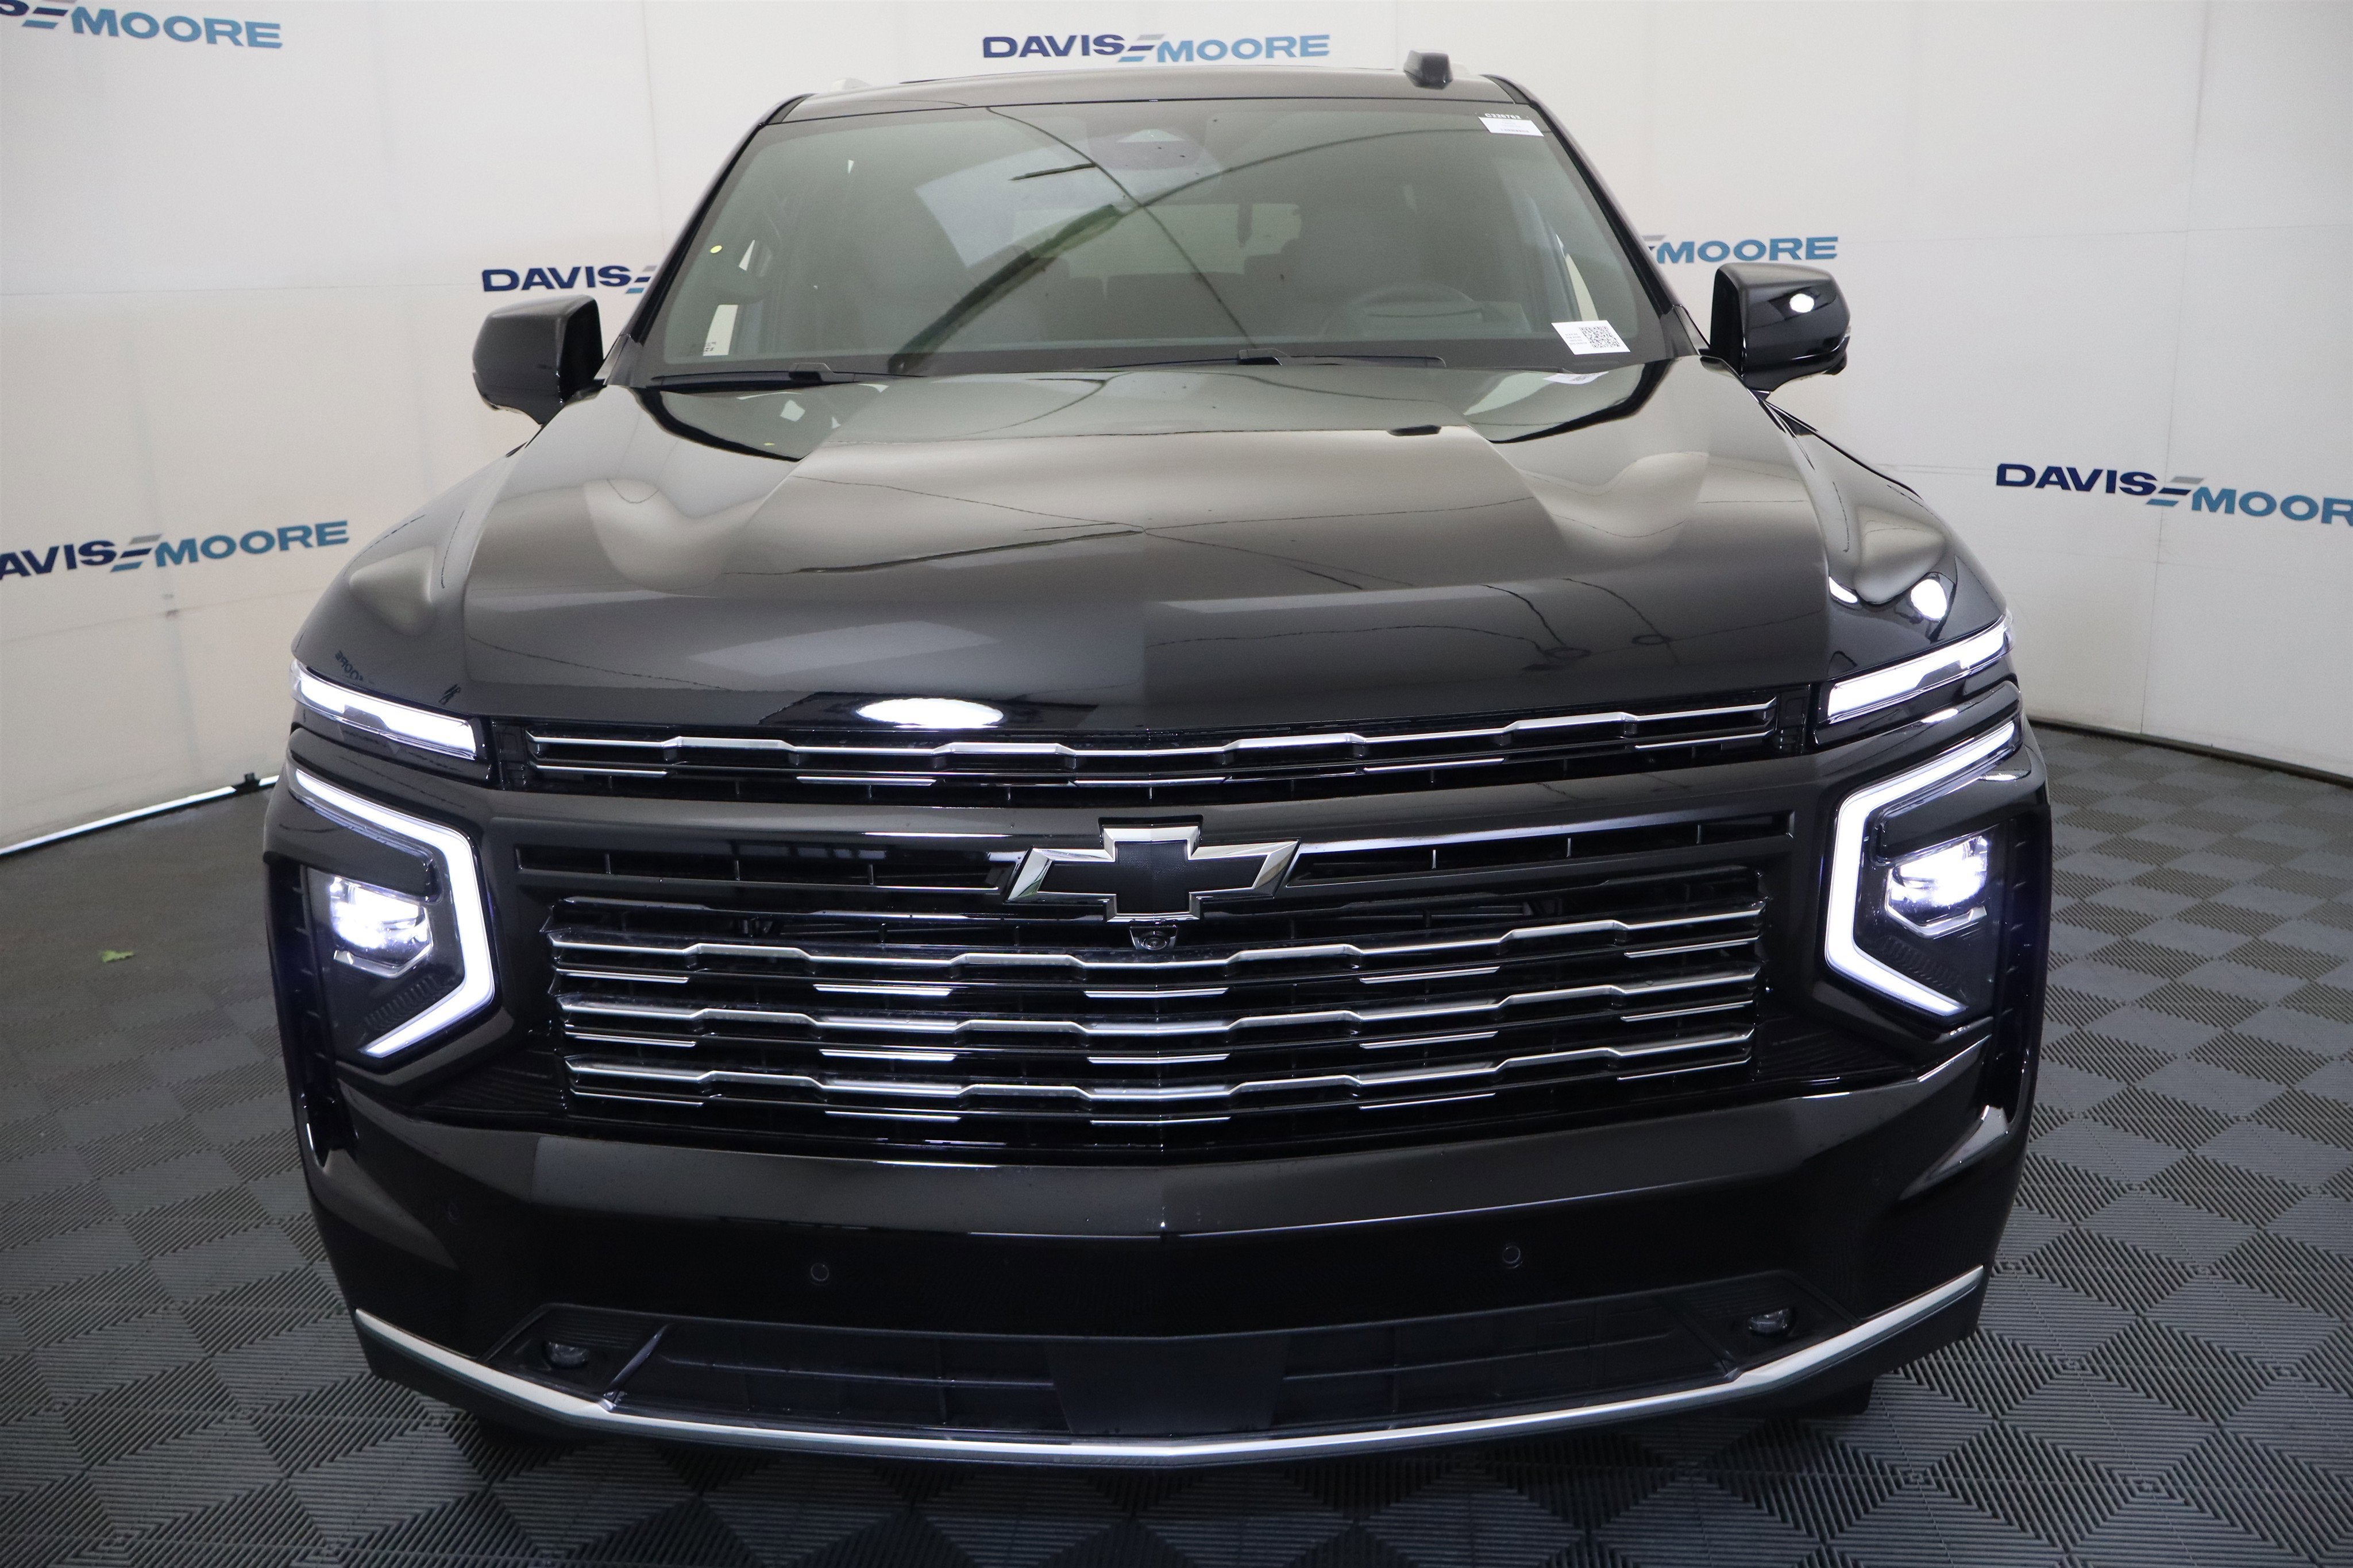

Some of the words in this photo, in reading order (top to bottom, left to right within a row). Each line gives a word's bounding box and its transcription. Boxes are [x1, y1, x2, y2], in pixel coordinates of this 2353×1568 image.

[71, 6, 283, 49] MOORE
[982, 34, 1125, 57] DAVIS
[1156, 34, 1330, 63] MOORE
[1657, 236, 1838, 264] MOORE
[482, 265, 631, 292] DAVIS
[1996, 463, 2157, 495] DAVIS
[155, 520, 349, 567] MOORE
